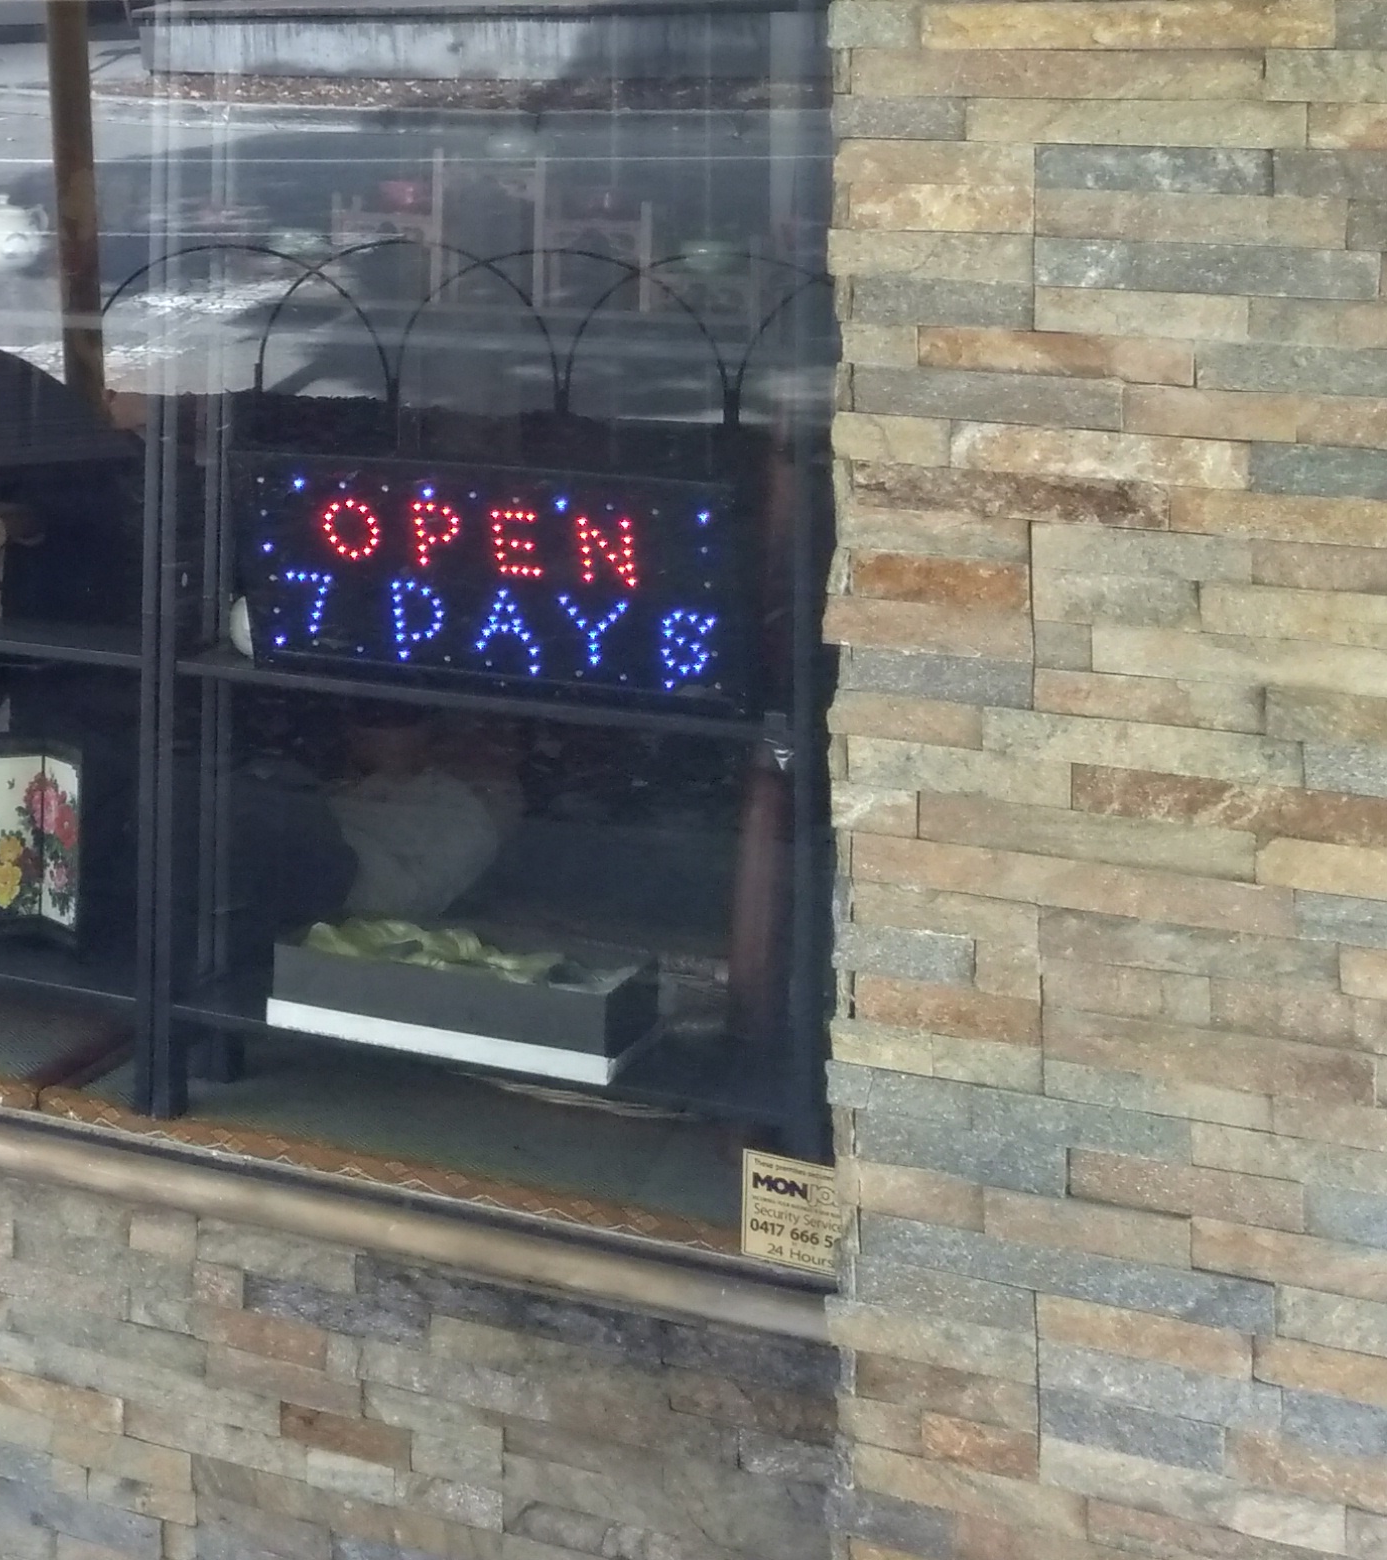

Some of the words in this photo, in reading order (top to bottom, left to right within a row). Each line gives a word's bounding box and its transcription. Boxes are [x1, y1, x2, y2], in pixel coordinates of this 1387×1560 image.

[322, 498, 638, 588] OPEN
[285, 569, 333, 634] 7
[754, 1203, 800, 1225] Security
[750, 1218, 785, 1236] 0417
[790, 1228, 819, 1245] 666
[767, 1243, 783, 1256] 24
[790, 1248, 834, 1267] Hours
